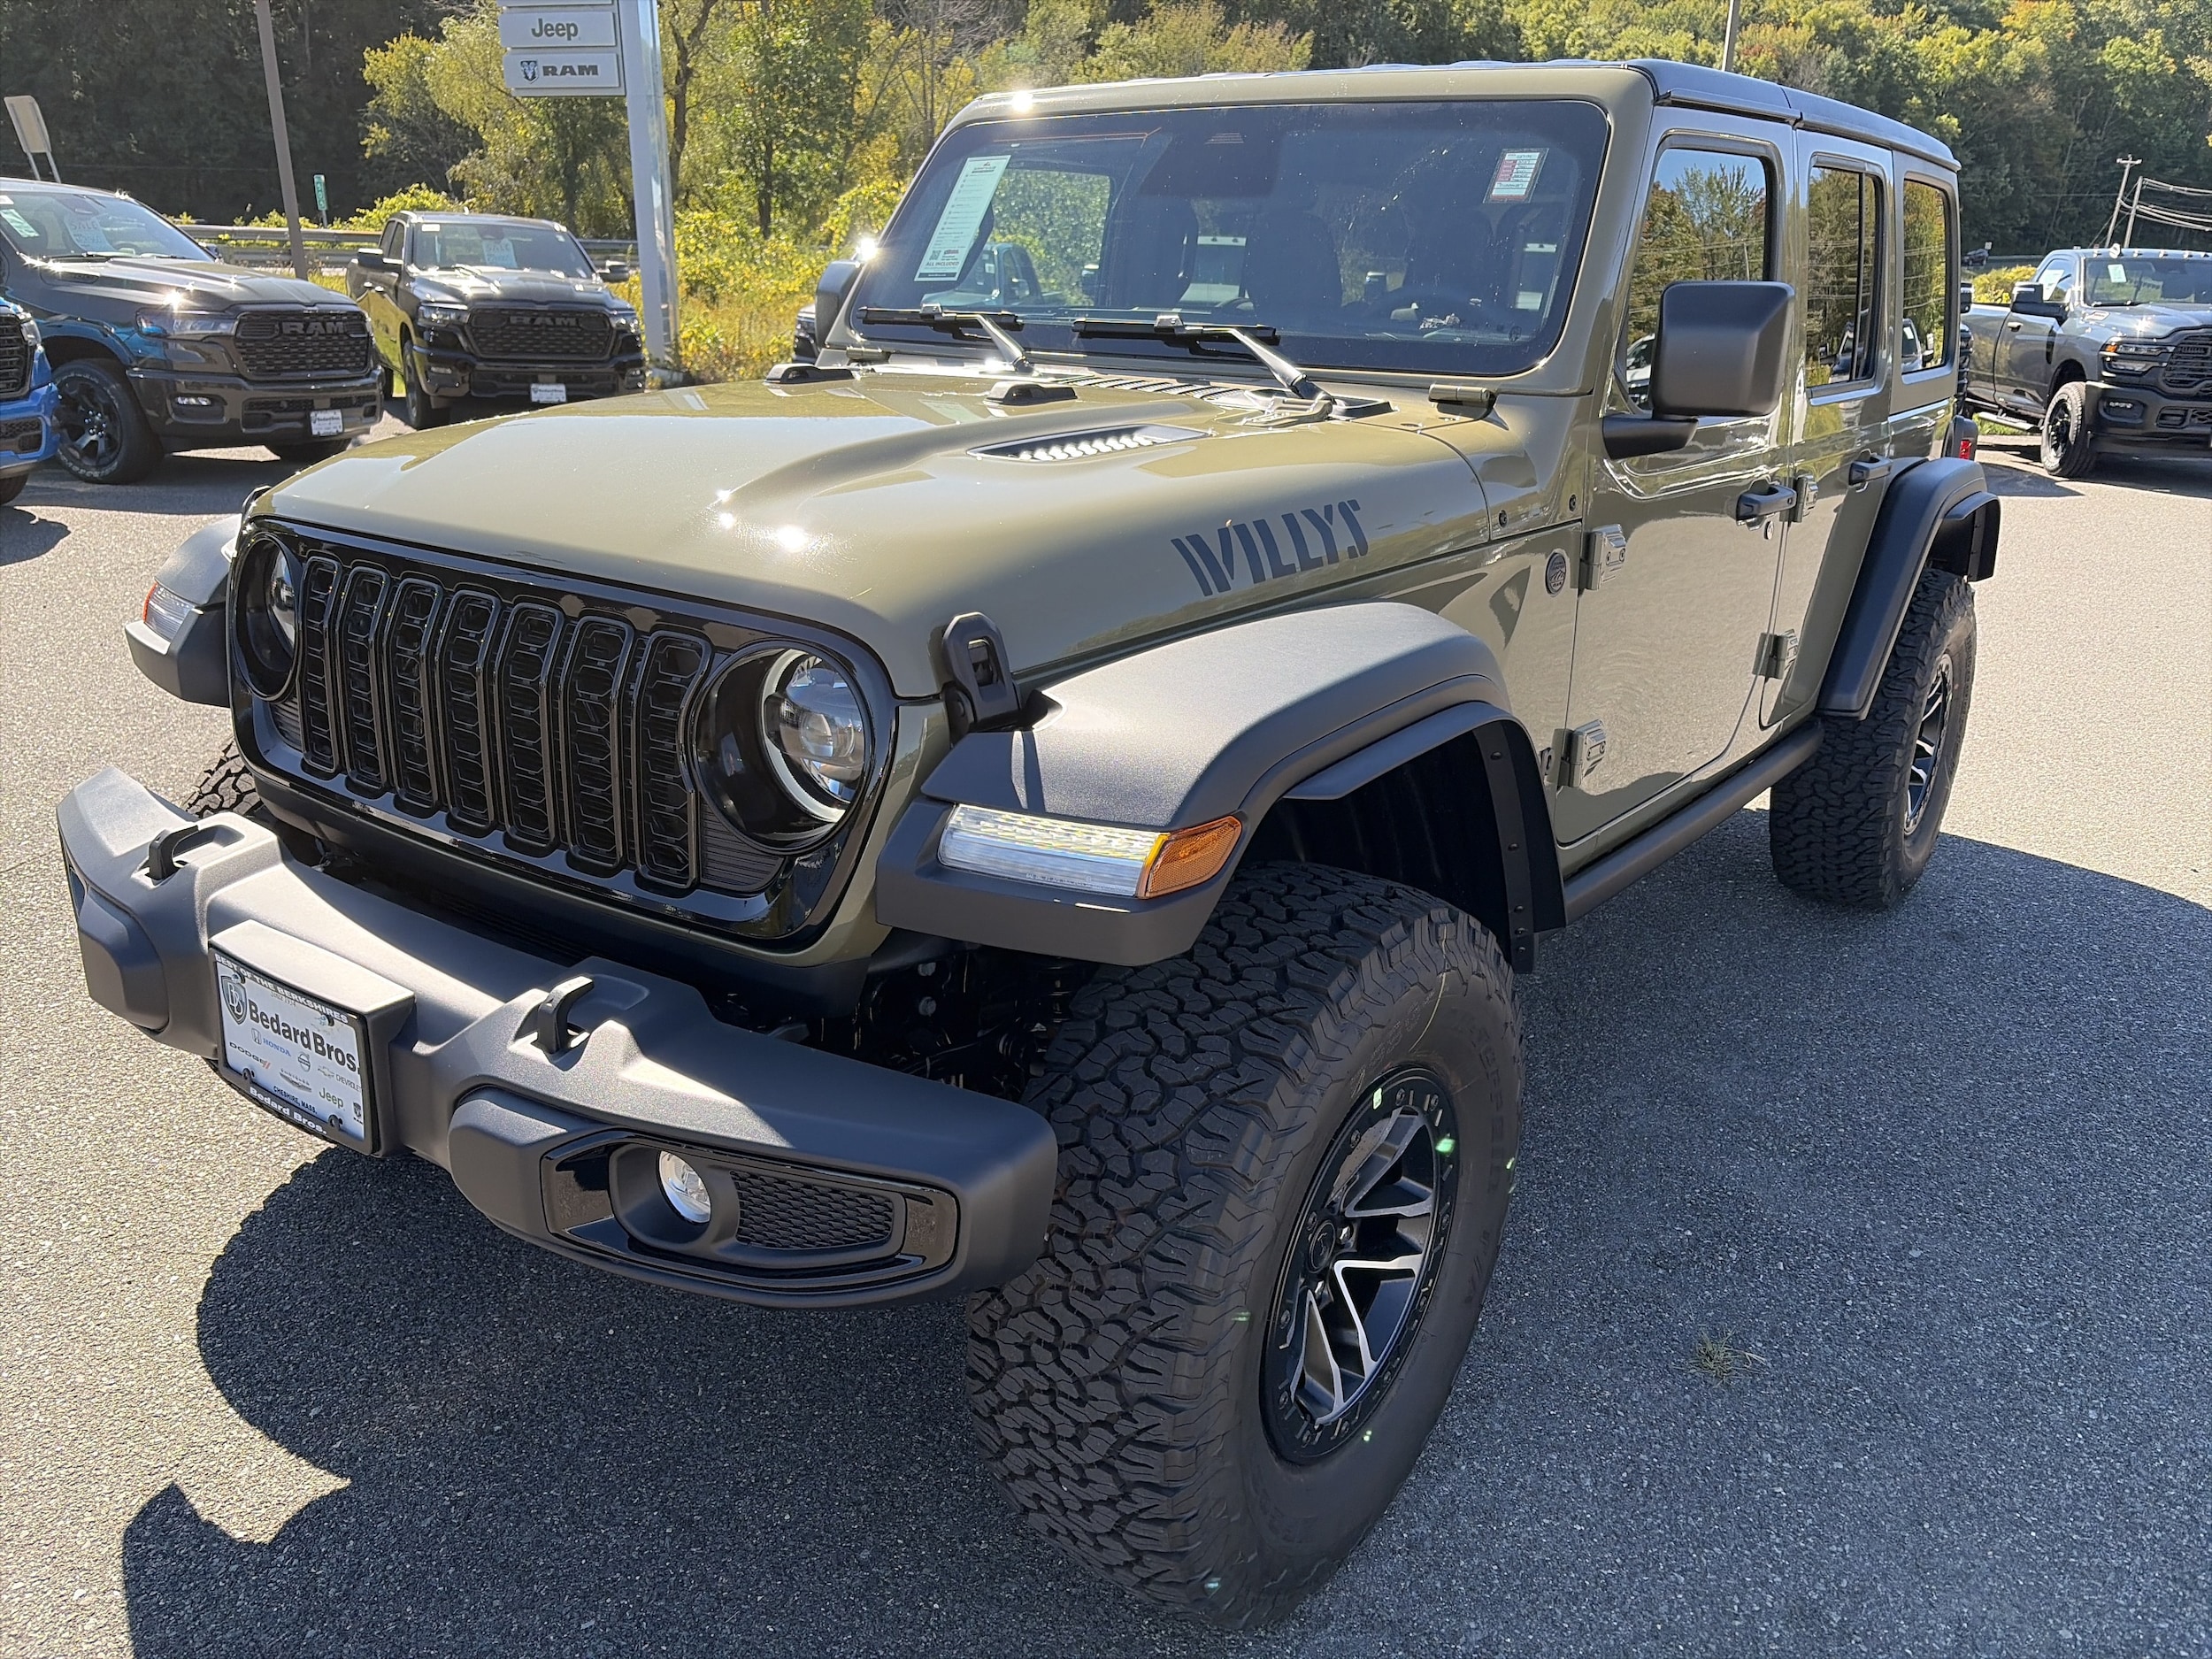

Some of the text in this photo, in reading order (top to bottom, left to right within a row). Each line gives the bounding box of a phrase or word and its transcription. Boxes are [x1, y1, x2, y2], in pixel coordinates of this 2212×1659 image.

[531, 18, 579, 41] Jeep
[542, 65, 599, 76] RAM
[282, 321, 344, 334] RAM
[510, 315, 577, 326] RAM
[1170, 499, 1369, 597] WILLYS
[214, 953, 349, 1024] BEST OF THE BERKSHIRES
[248, 999, 361, 1074] Bedard Bros.
[263, 1037, 292, 1057] HONDA
[229, 1041, 267, 1067] DODGE
[319, 1087, 344, 1110] Jeep
[250, 1087, 327, 1135] Bedard Bros.
